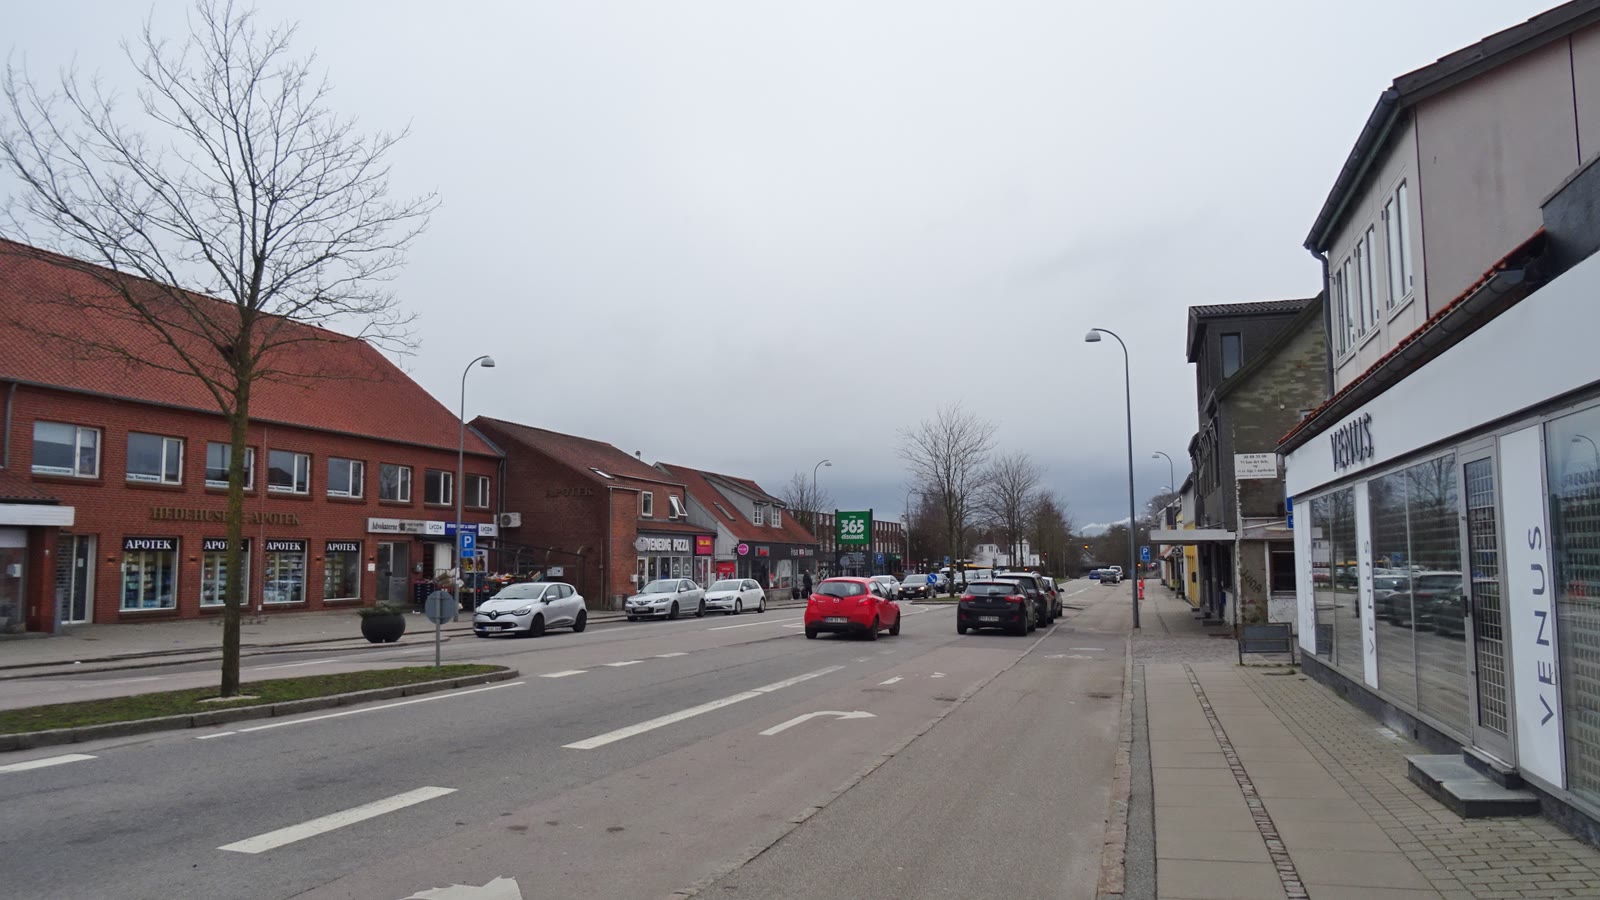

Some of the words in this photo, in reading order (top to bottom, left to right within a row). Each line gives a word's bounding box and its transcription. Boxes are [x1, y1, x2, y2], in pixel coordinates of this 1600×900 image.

[1330, 412, 1373, 472] VENUS
[251, 512, 301, 525] APOTEK
[841, 519, 865, 534] 365
[125, 539, 172, 550] APOTEK
[266, 541, 301, 551] APOTEK
[326, 542, 358, 552] APOTEK
[464, 536, 472, 548] P
[672, 539, 690, 551] PIZZA
[1142, 547, 1149, 555] P
[1528, 525, 1554, 727] VENUS
